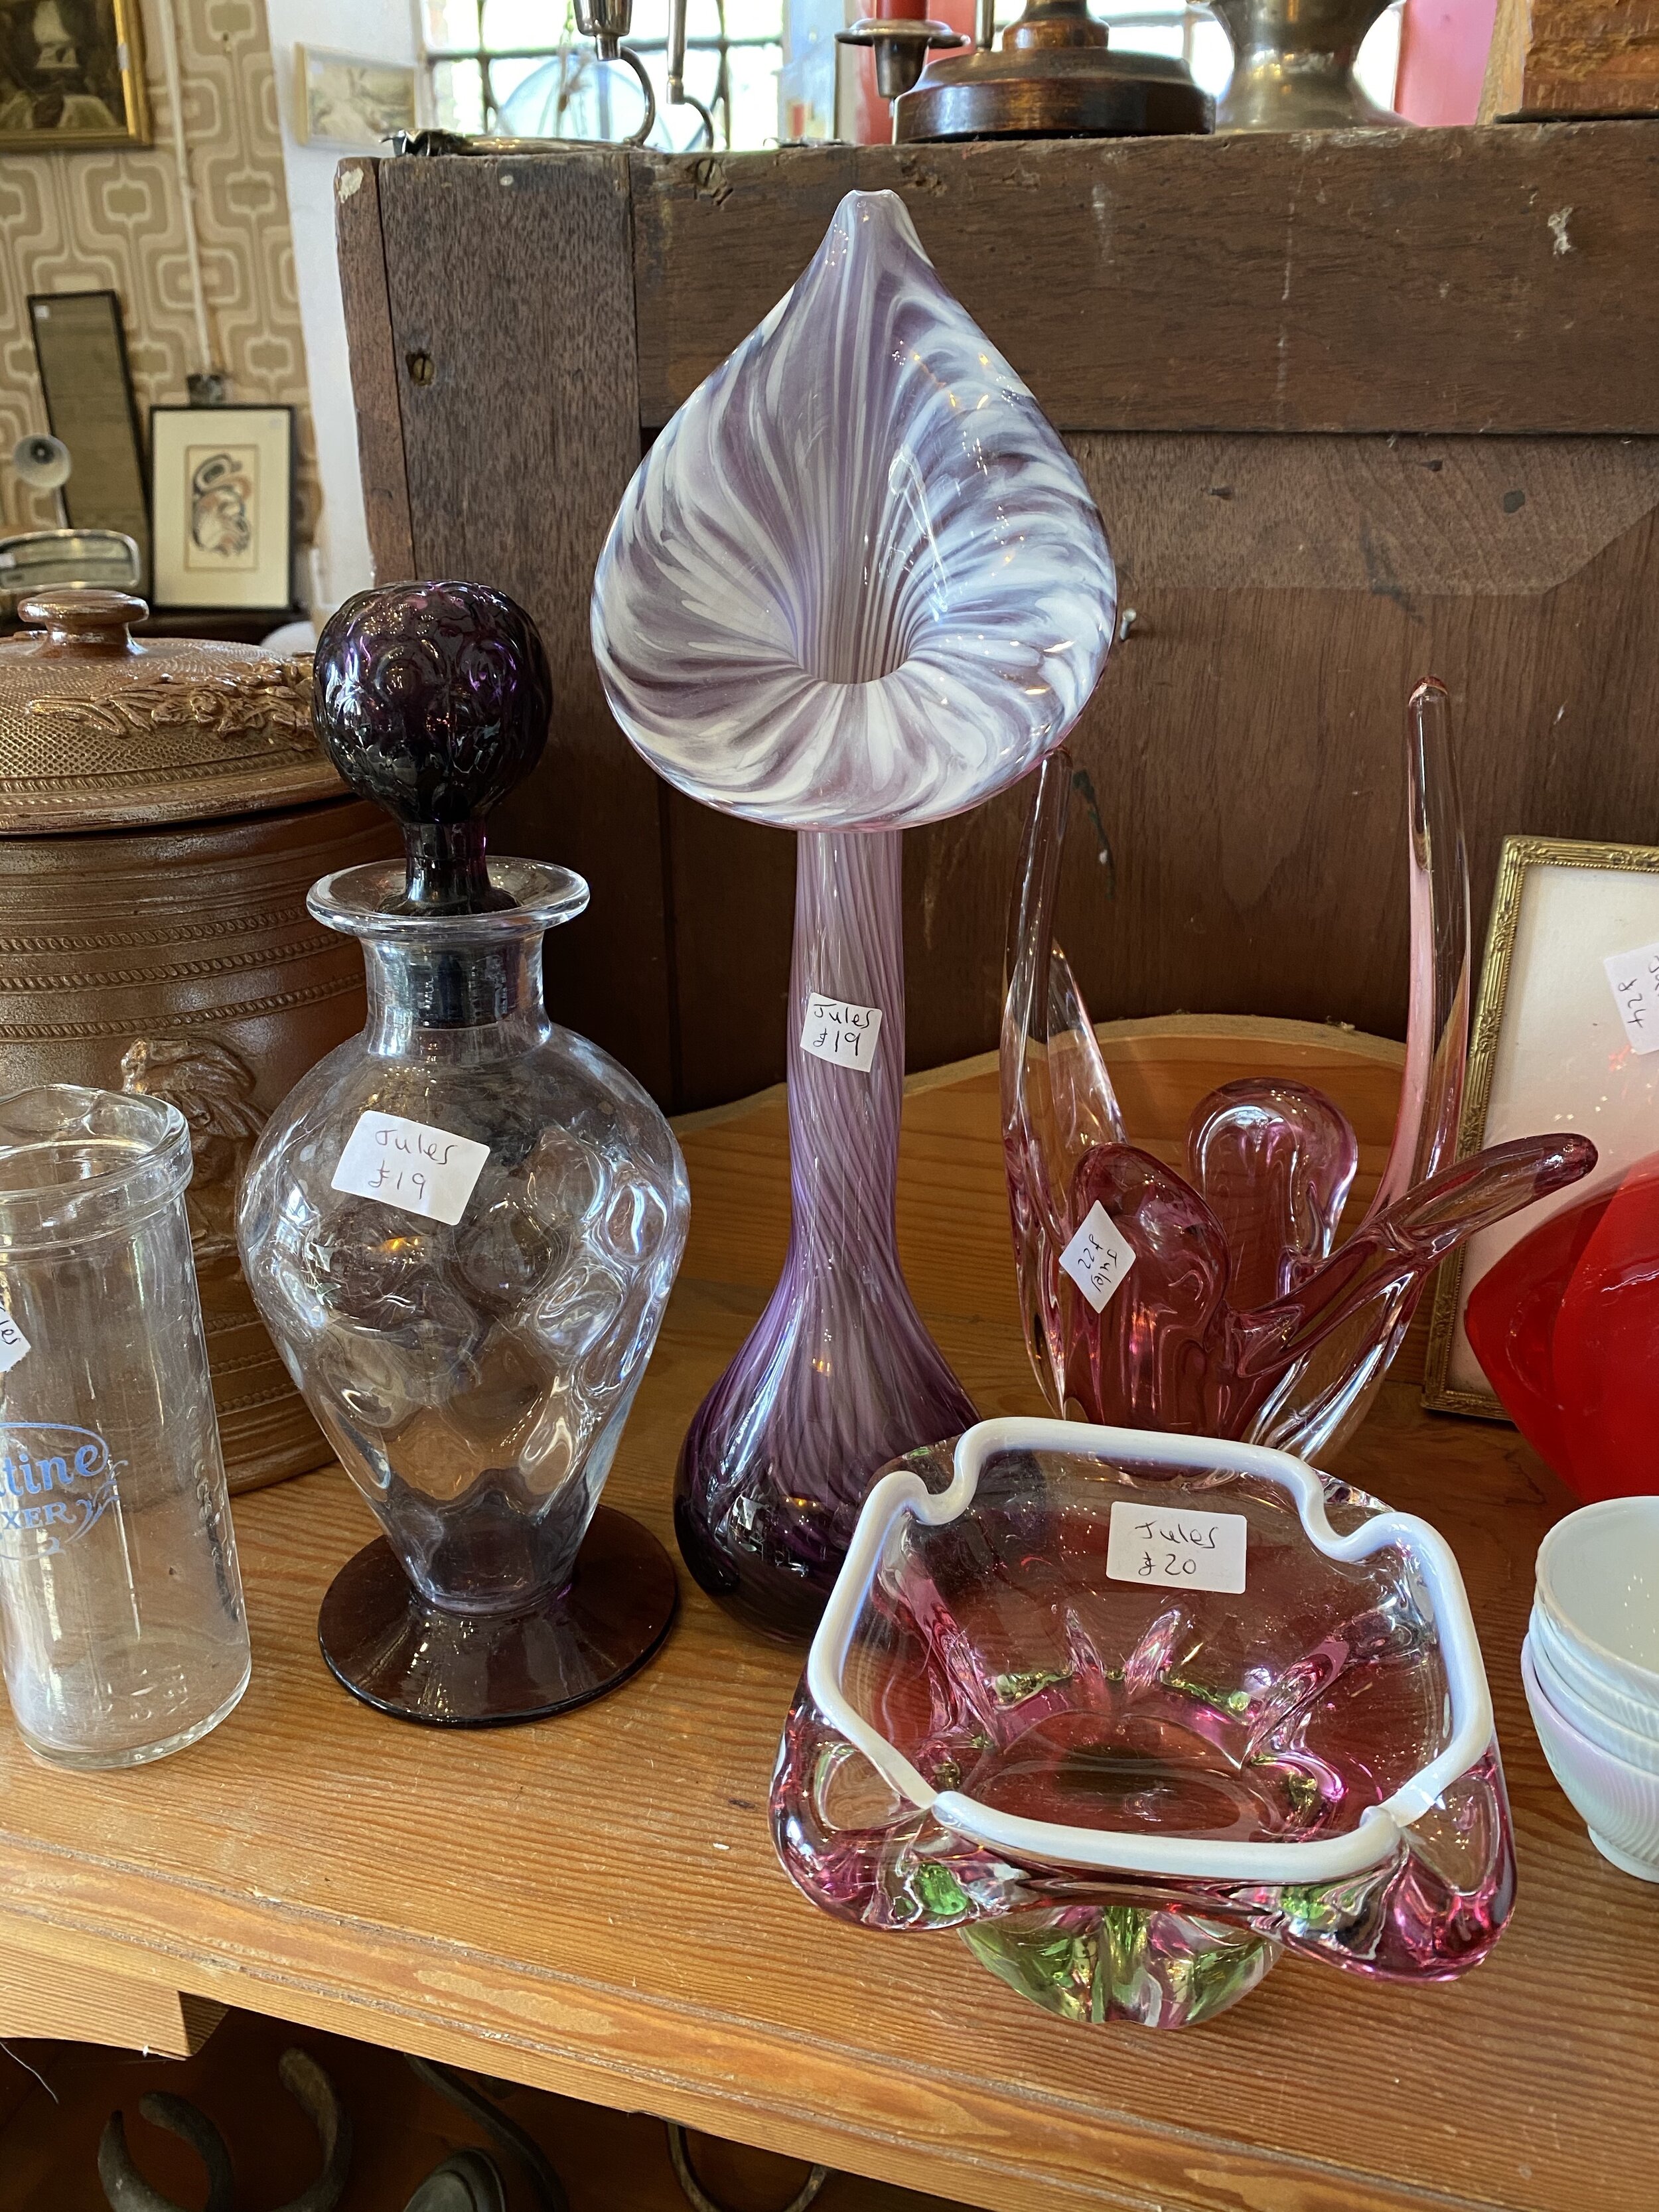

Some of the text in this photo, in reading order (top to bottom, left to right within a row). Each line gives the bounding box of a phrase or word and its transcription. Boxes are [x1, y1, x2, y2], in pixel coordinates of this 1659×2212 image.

[814, 1003, 875, 1029] Jules
[1619, 978, 1646, 1028] £24
[813, 1028, 861, 1056] £19
[375, 1130, 457, 1164] Jules
[368, 1160, 426, 1199] £19
[1078, 1234, 1103, 1269] £22
[0, 1445, 98, 1497] tine
[1135, 1520, 1218, 1549] Jules
[1138, 1552, 1196, 1576] £20
